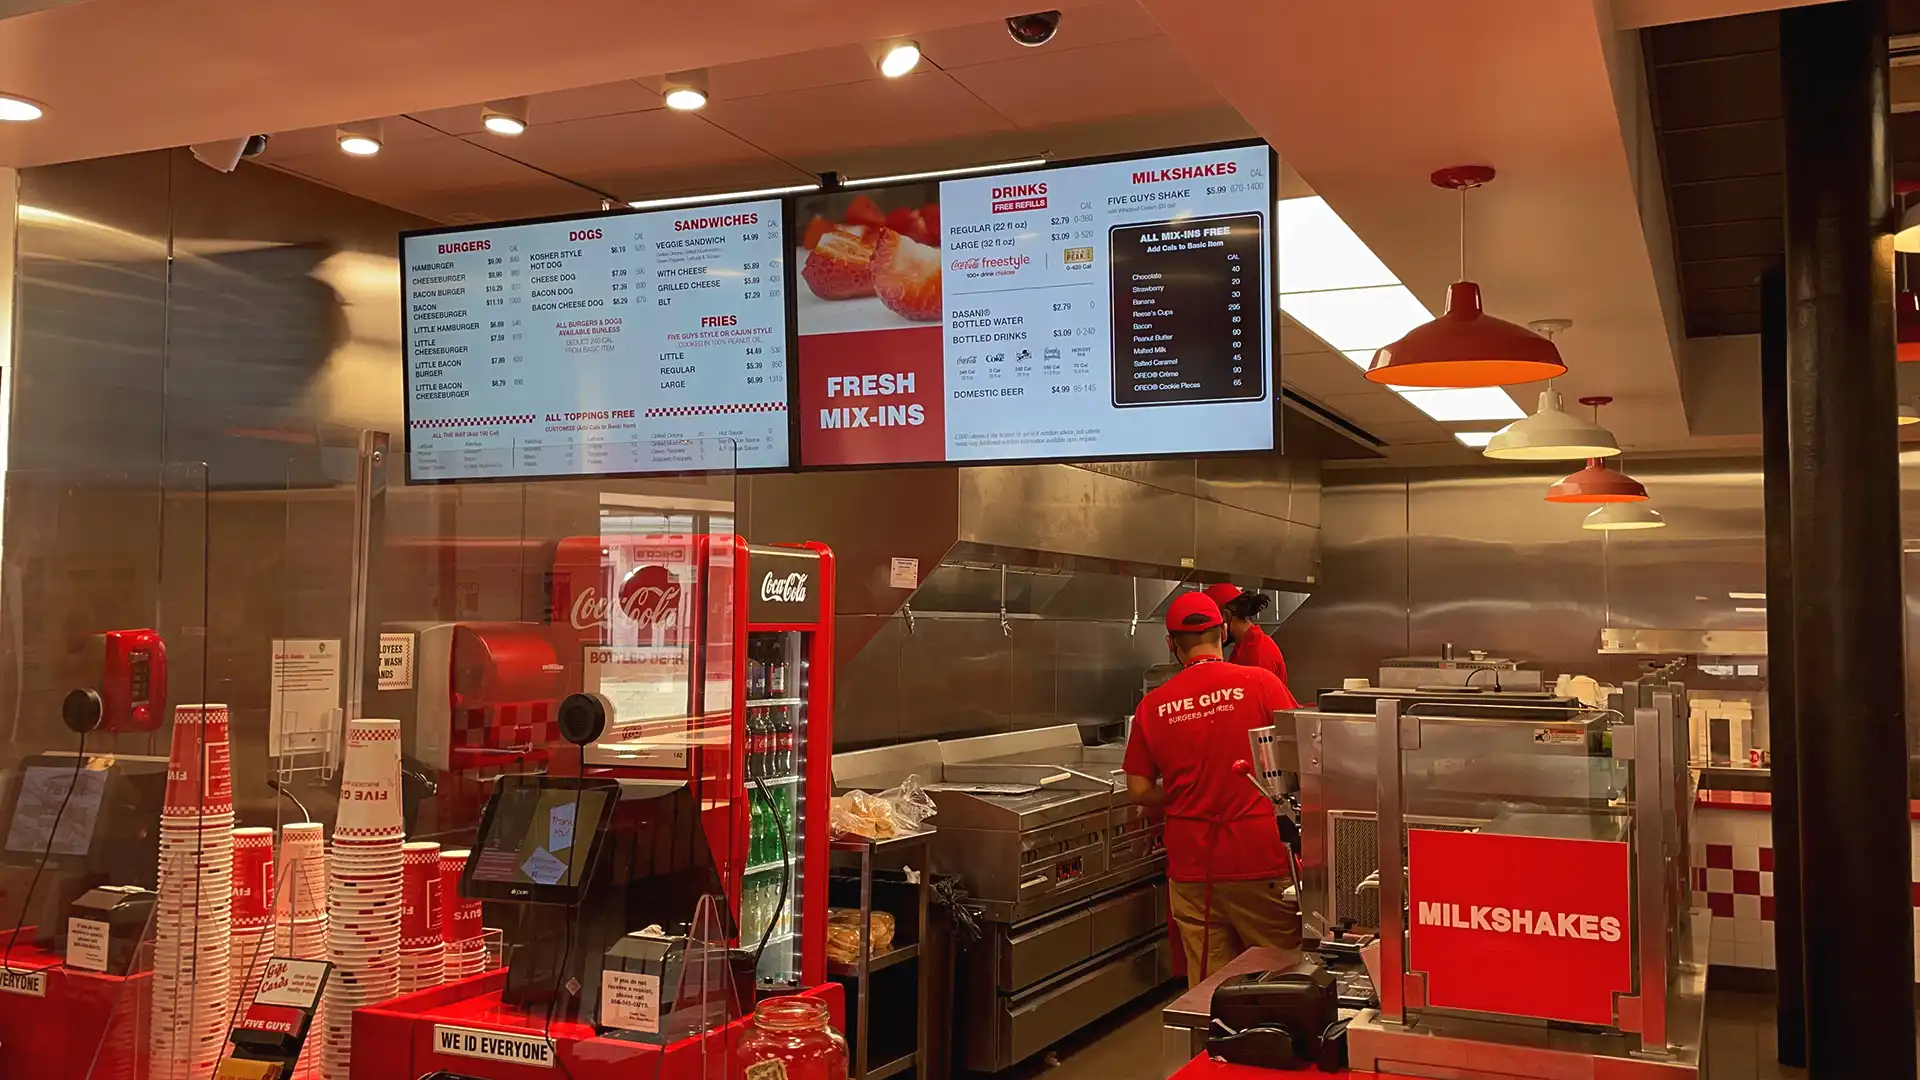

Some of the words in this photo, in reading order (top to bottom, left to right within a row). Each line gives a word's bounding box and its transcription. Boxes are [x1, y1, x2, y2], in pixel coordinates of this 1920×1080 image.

[1132, 161, 1237, 185] MILKSHAKES
[1250, 168, 1263, 177] CAL
[992, 182, 1048, 199] DRINKS
[1206, 186, 1227, 196] $5.99
[1108, 195, 1127, 205] FIVE
[1130, 193, 1156, 203] GUYS
[1158, 189, 1190, 200] SHAKE
[994, 202, 1014, 211] FREE
[1015, 199, 1045, 209] REFILLS
[1080, 202, 1092, 210] CAL
[674, 213, 759, 232] SANDWICHES
[1051, 216, 1070, 226] $2.79
[950, 223, 991, 235] REGULAR
[993, 223, 1006, 233] (22
[1007, 222, 1013, 230] fl
[1015, 221, 1028, 230] oz)
[569, 228, 603, 241] DOGS
[742, 233, 759, 241] $4.99
[1051, 233, 1070, 242] $3.09
[1140, 234, 1159, 243] ALL
[1161, 230, 1201, 241] MIX-INS
[1203, 226, 1231, 237] FREE
[438, 239, 491, 254] BURGERS
[656, 240, 683, 249] VEGGIE
[685, 236, 726, 247] SANDWICH
[950, 240, 979, 251] LARGE
[980, 239, 994, 249] (32
[995, 238, 1001, 246] fl
[1003, 237, 1015, 246] oz)
[1147, 245, 1161, 253] Add
[1187, 241, 1206, 250] Basic
[1207, 240, 1224, 248] Item
[530, 252, 559, 261] KOSHER
[560, 250, 582, 259] STYLE
[412, 262, 454, 272] HAMBURGER
[530, 262, 545, 270] HOT
[546, 261, 562, 269] DOG
[982, 253, 1030, 270] freestyle
[657, 268, 676, 277] WITH
[677, 266, 707, 276] CHEESE
[1132, 273, 1162, 281] Chocolate
[412, 274, 466, 285] CHEESEBURGER
[530, 274, 559, 284] CHEESE
[560, 273, 576, 282] DOG
[657, 282, 689, 292] GRILLED
[690, 280, 721, 289] CHEESE
[1132, 285, 1164, 294] Strawberry
[413, 290, 437, 298] BACON
[437, 287, 466, 296] BURGER
[531, 289, 556, 297] BACON
[558, 288, 574, 296] DOG
[532, 303, 557, 312] BACON
[558, 300, 587, 310] CHEESE
[588, 299, 604, 307] DOG
[658, 298, 671, 306] BLT
[1052, 302, 1071, 312] $2.79
[1132, 298, 1155, 306] Banana
[413, 304, 437, 312] BACON
[1157, 309, 1174, 317] Cups
[414, 310, 467, 321] CHEESEBURGER
[701, 315, 737, 328] FRIES
[952, 318, 992, 329] BOTTLED
[993, 317, 1024, 326] WATER
[414, 326, 435, 334] LITTLE
[437, 322, 480, 332] HAMBURGER
[1053, 329, 1072, 338] $3.09
[414, 339, 436, 347] LITTLE
[952, 334, 992, 344] BOTTLED
[993, 332, 1027, 341] DRINKS
[1133, 335, 1154, 343] Peanut
[414, 346, 469, 356] CHEESEBURGER
[660, 352, 684, 361] LITTLE
[1133, 347, 1154, 355] Malted
[415, 360, 437, 369] LITTLE
[1153, 358, 1178, 366] Caramel
[415, 370, 443, 378] BURGER
[660, 366, 696, 375] REGULAR
[416, 383, 437, 391] LITTLE
[439, 382, 462, 390] BACON
[661, 380, 686, 389] LARGE
[827, 372, 915, 398] FRESH
[1051, 385, 1070, 394] $4.99
[416, 391, 470, 400] CHEESEBURGER
[953, 389, 999, 399] DOMESTIC
[1000, 388, 1024, 397] BEER
[545, 413, 561, 422] ALL
[564, 411, 609, 421] TOPPINGS
[611, 410, 635, 418] FREE
[820, 404, 925, 429] MIX-INS
[761, 571, 808, 602] Coca-Cola
[384, 657, 403, 666] WASH
[1158, 697, 1195, 717] FIVE
[1199, 687, 1245, 707] GUYS
[1168, 711, 1203, 725] BURGERS
[1203, 709, 1215, 717] and
[1216, 703, 1235, 712] FRIES
[355, 790, 388, 801] FIVE
[1418, 901, 1621, 942] MILKSHAKES
[266, 962, 288, 979] Gift
[261, 977, 289, 993] Cards
[243, 1019, 265, 1028] FIVE
[266, 1021, 292, 1031] GUYS
[441, 1032, 460, 1049] WE
[464, 1035, 477, 1052] ID
[481, 1037, 548, 1061] EVERYONE
